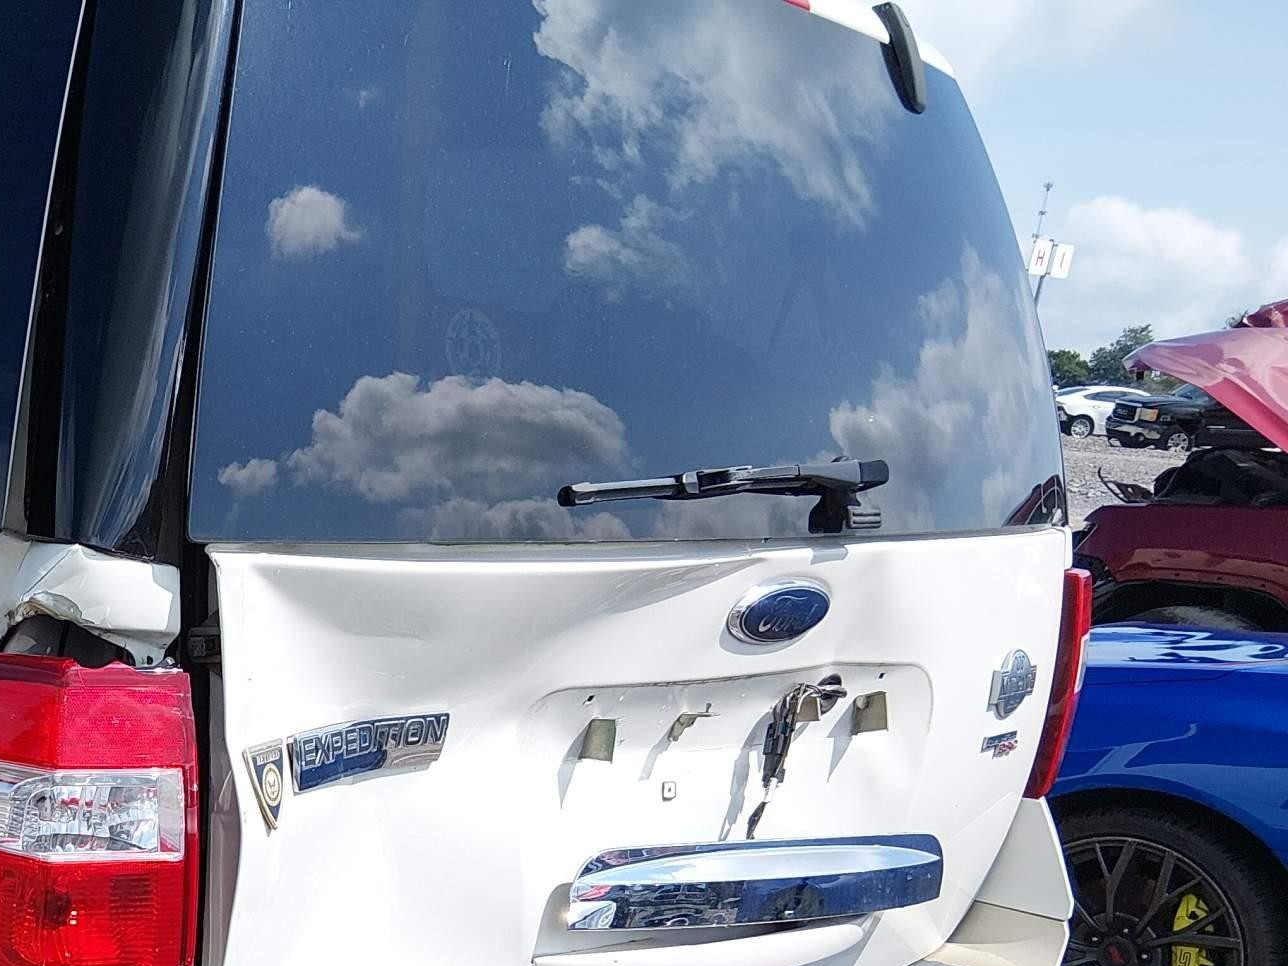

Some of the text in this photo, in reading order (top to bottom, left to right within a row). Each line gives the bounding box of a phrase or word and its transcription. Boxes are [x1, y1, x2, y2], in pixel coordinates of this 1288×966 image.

[1034, 249, 1046, 267] H
[757, 594, 820, 634] Ford
[298, 714, 449, 769] EXPEDITION
